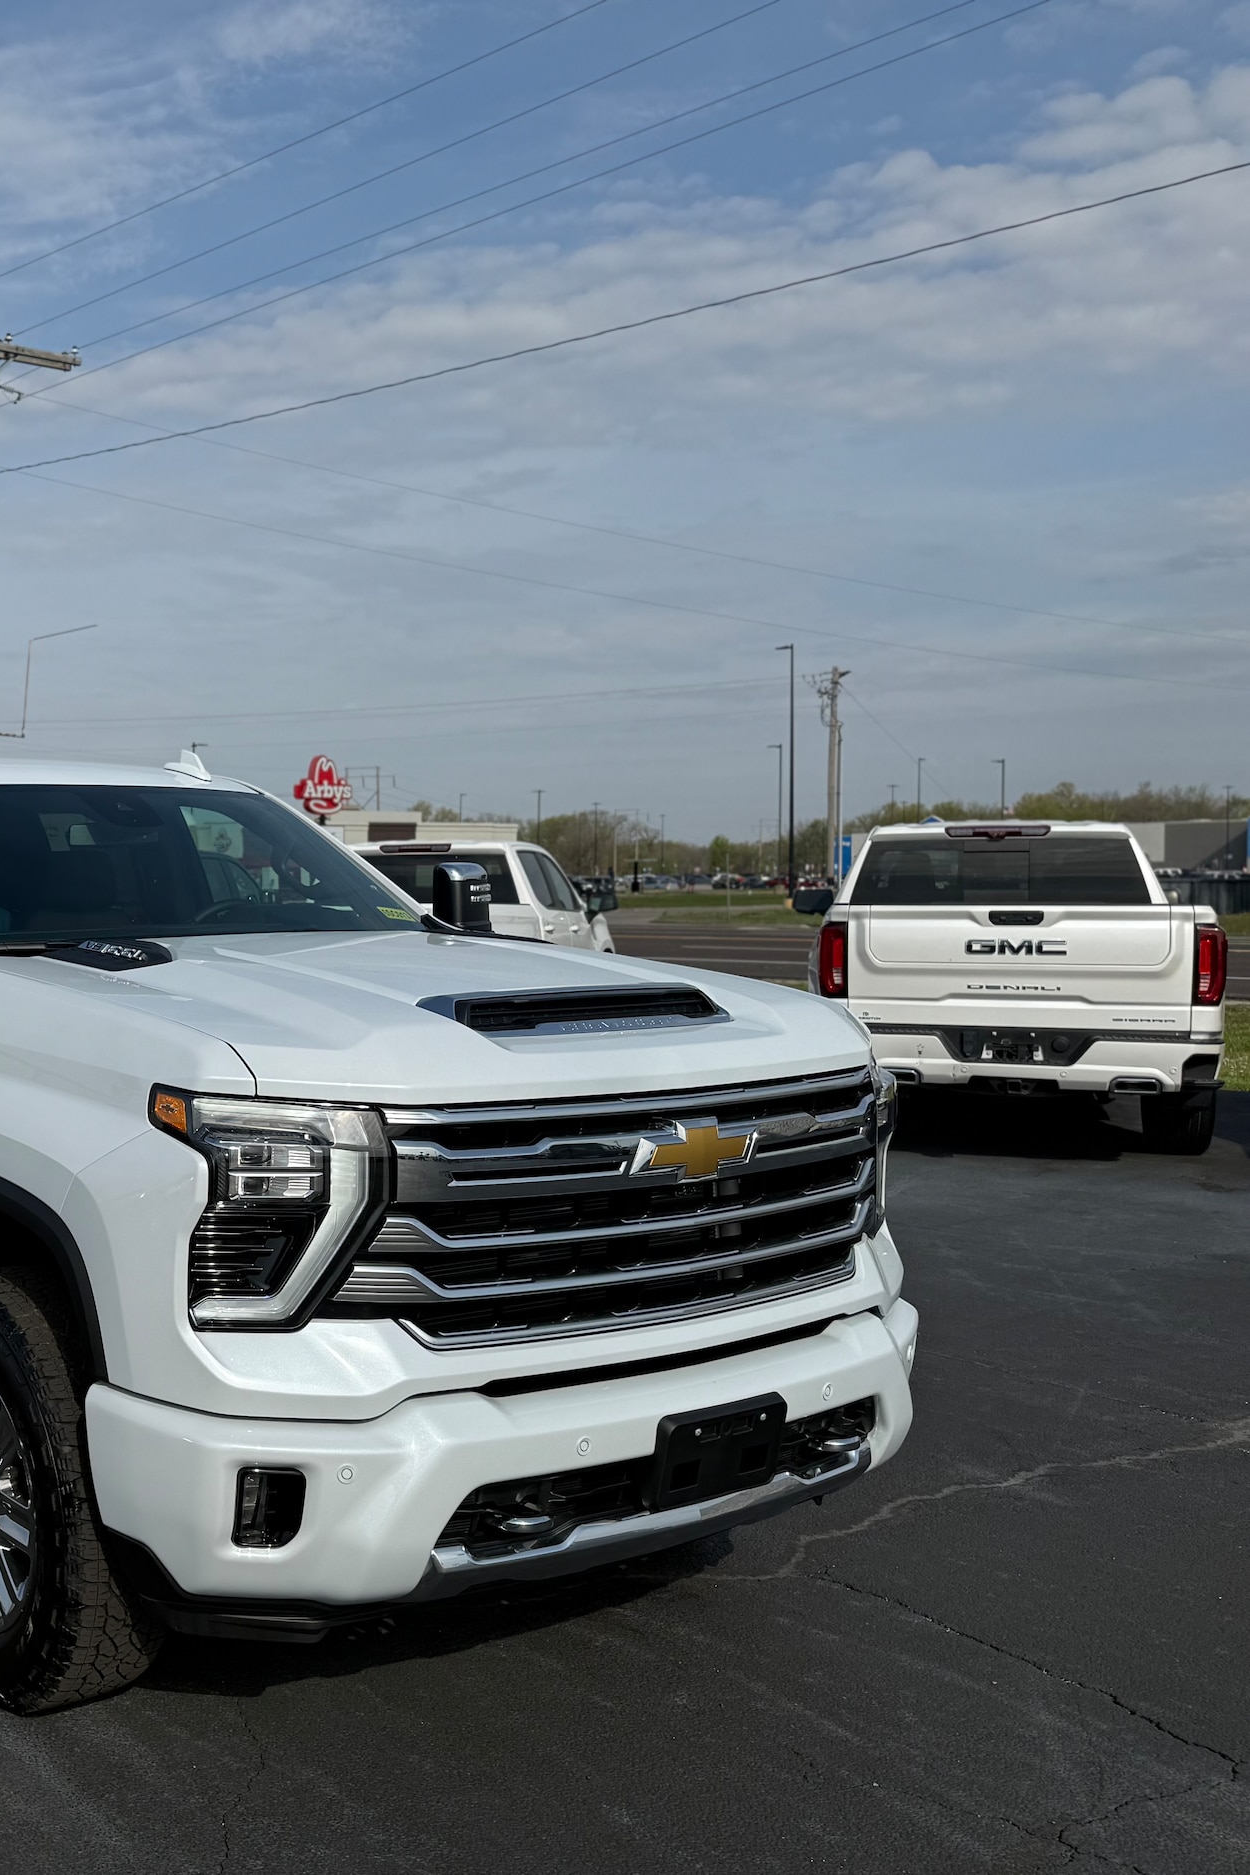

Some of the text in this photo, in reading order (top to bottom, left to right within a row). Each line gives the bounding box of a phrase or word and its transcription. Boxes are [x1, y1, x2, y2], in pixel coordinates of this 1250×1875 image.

[303, 779, 352, 803] Arby's
[964, 938, 1068, 956] GMC
[966, 984, 1062, 992] DENALI
